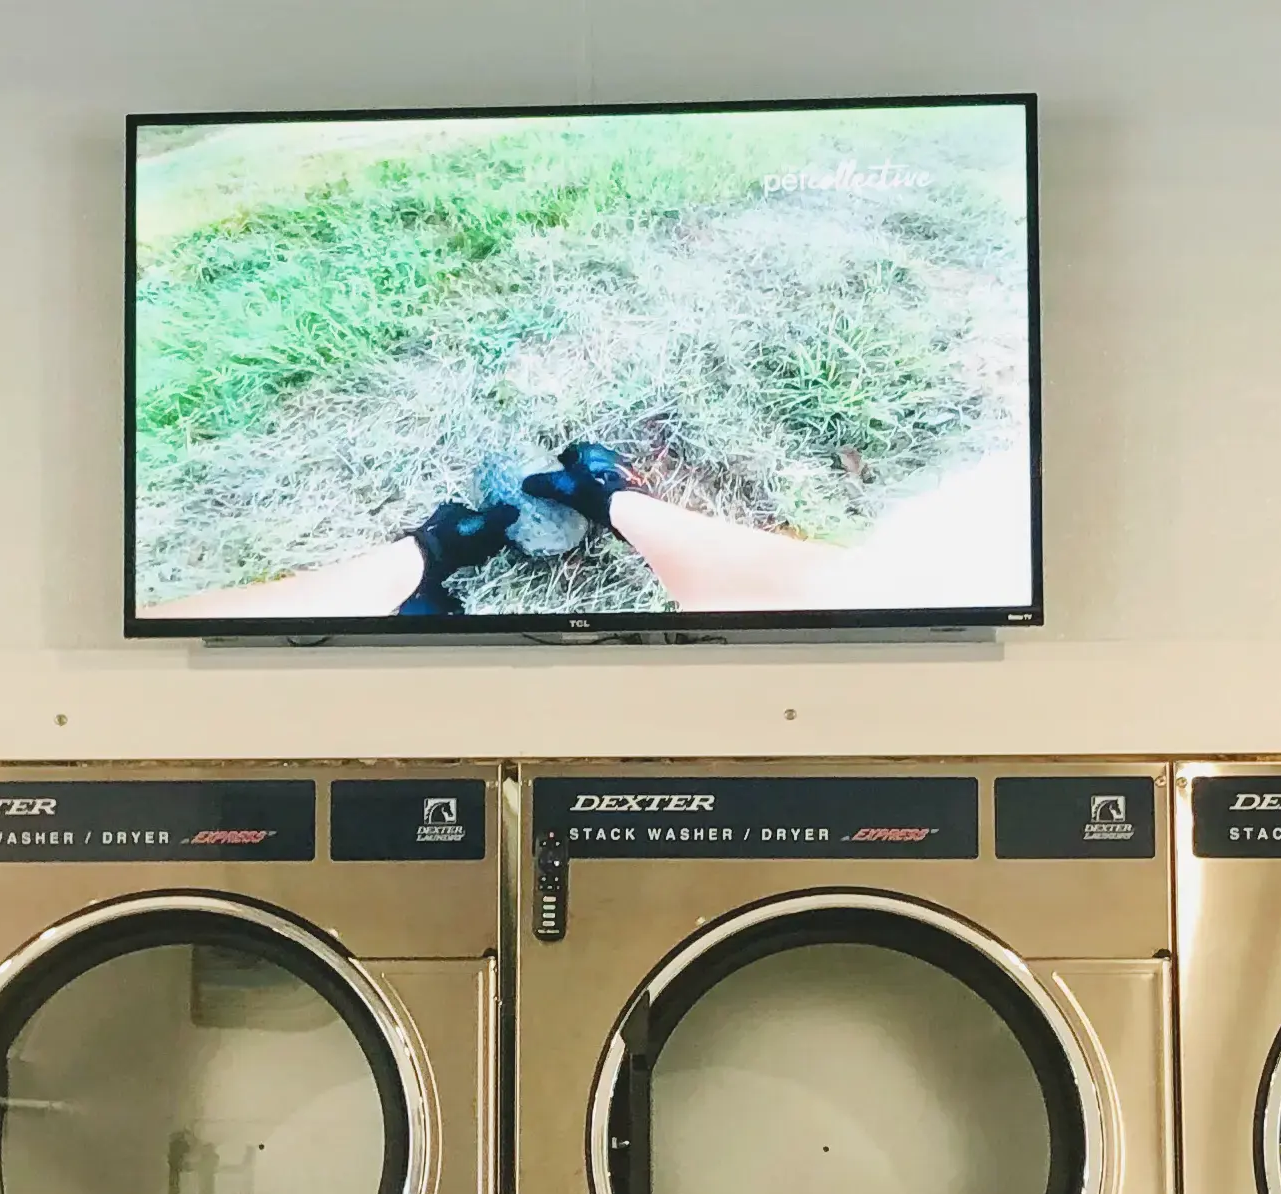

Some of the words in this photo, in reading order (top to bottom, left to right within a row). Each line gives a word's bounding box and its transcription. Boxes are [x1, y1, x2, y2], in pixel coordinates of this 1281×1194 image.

[569, 619, 591, 628] TCL
[570, 795, 715, 812] DEXTER
[416, 826, 464, 835] DEXTER
[569, 827, 636, 841] STACK
[647, 827, 733, 841] WASHER
[761, 827, 829, 841] DRYER
[1084, 823, 1133, 833] DEXTER
[102, 831, 170, 845] DRYER
